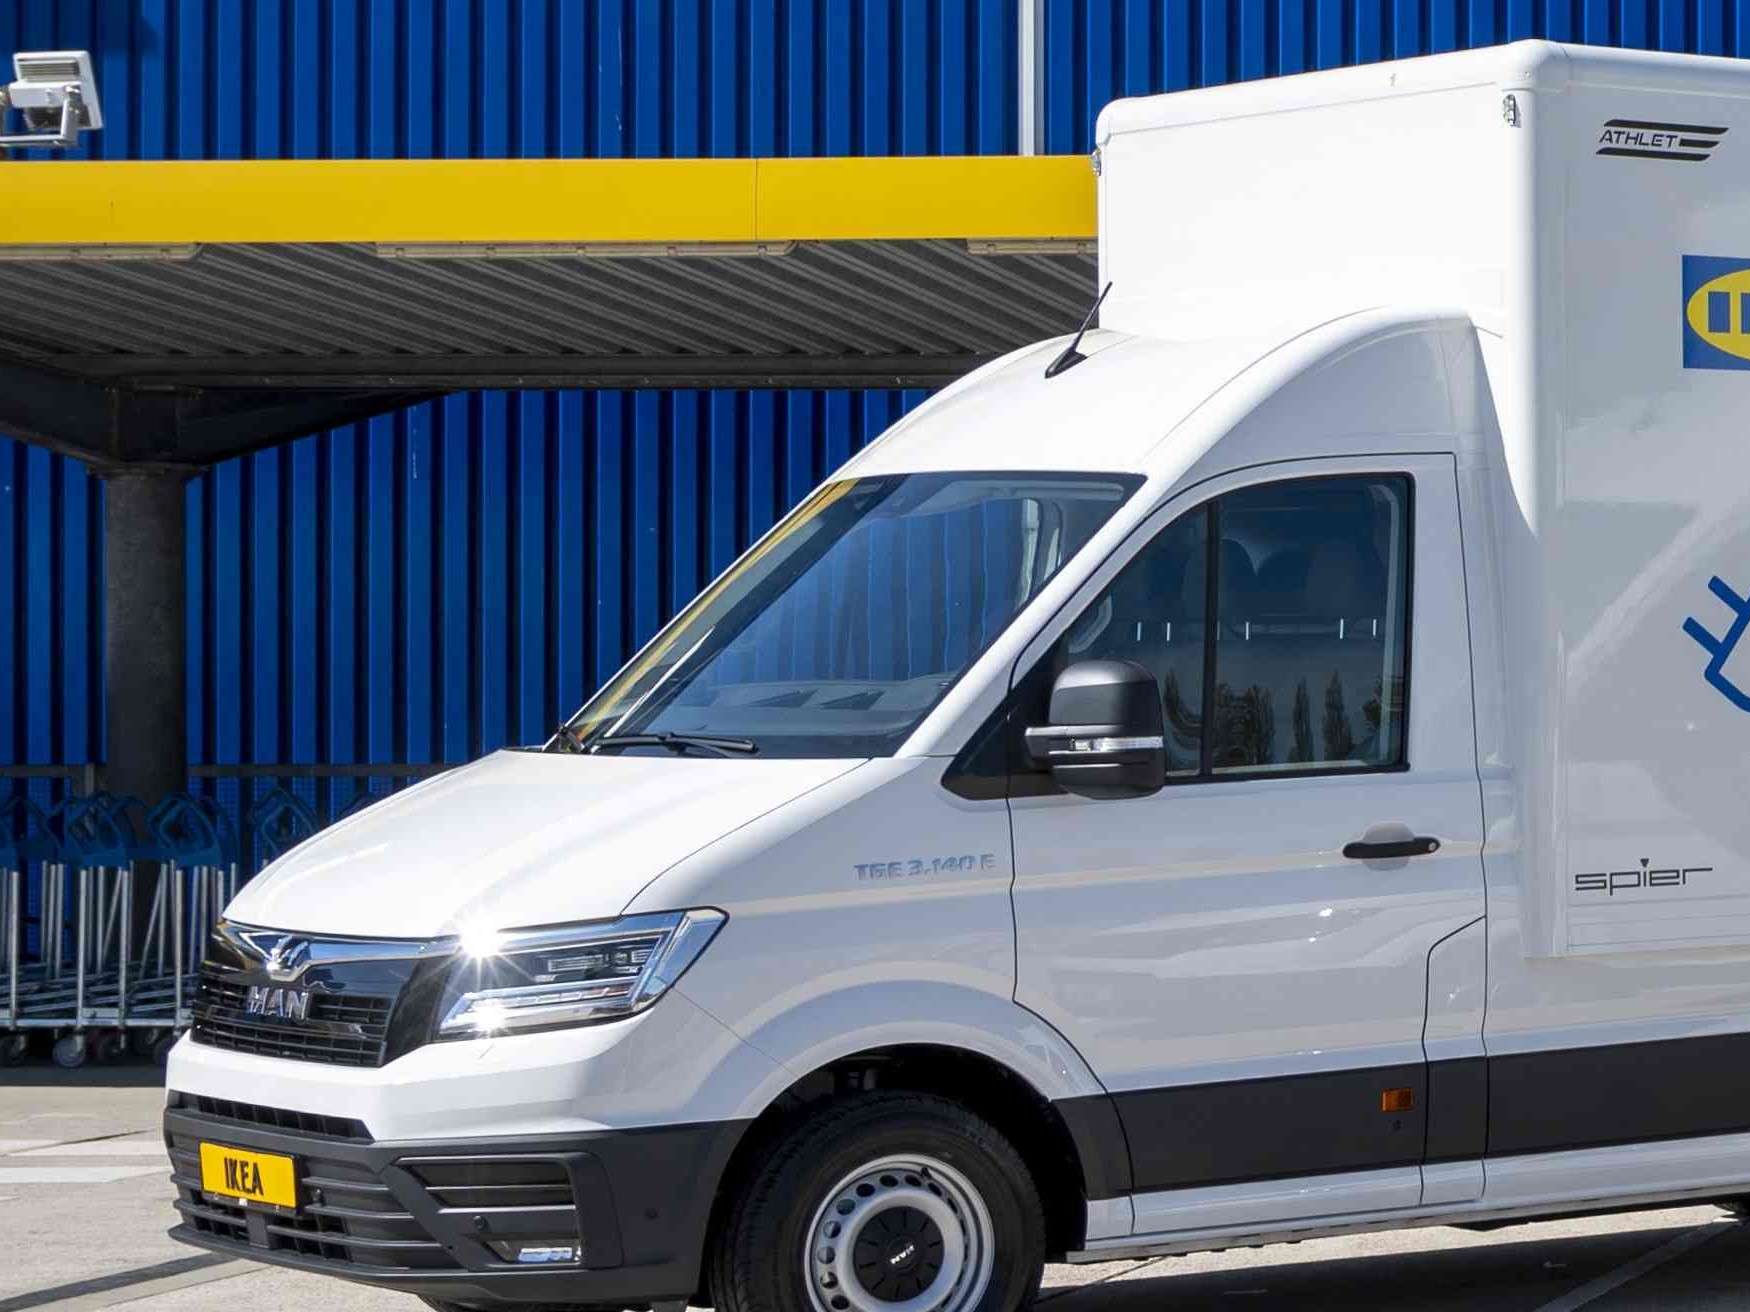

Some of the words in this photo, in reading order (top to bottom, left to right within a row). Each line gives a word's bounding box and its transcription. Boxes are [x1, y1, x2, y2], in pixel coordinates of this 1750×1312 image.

[1600, 129, 1678, 149] ATHLET
[1575, 858, 1713, 896] spier
[247, 986, 309, 1022] MAN
[224, 1156, 264, 1196] IKEA
